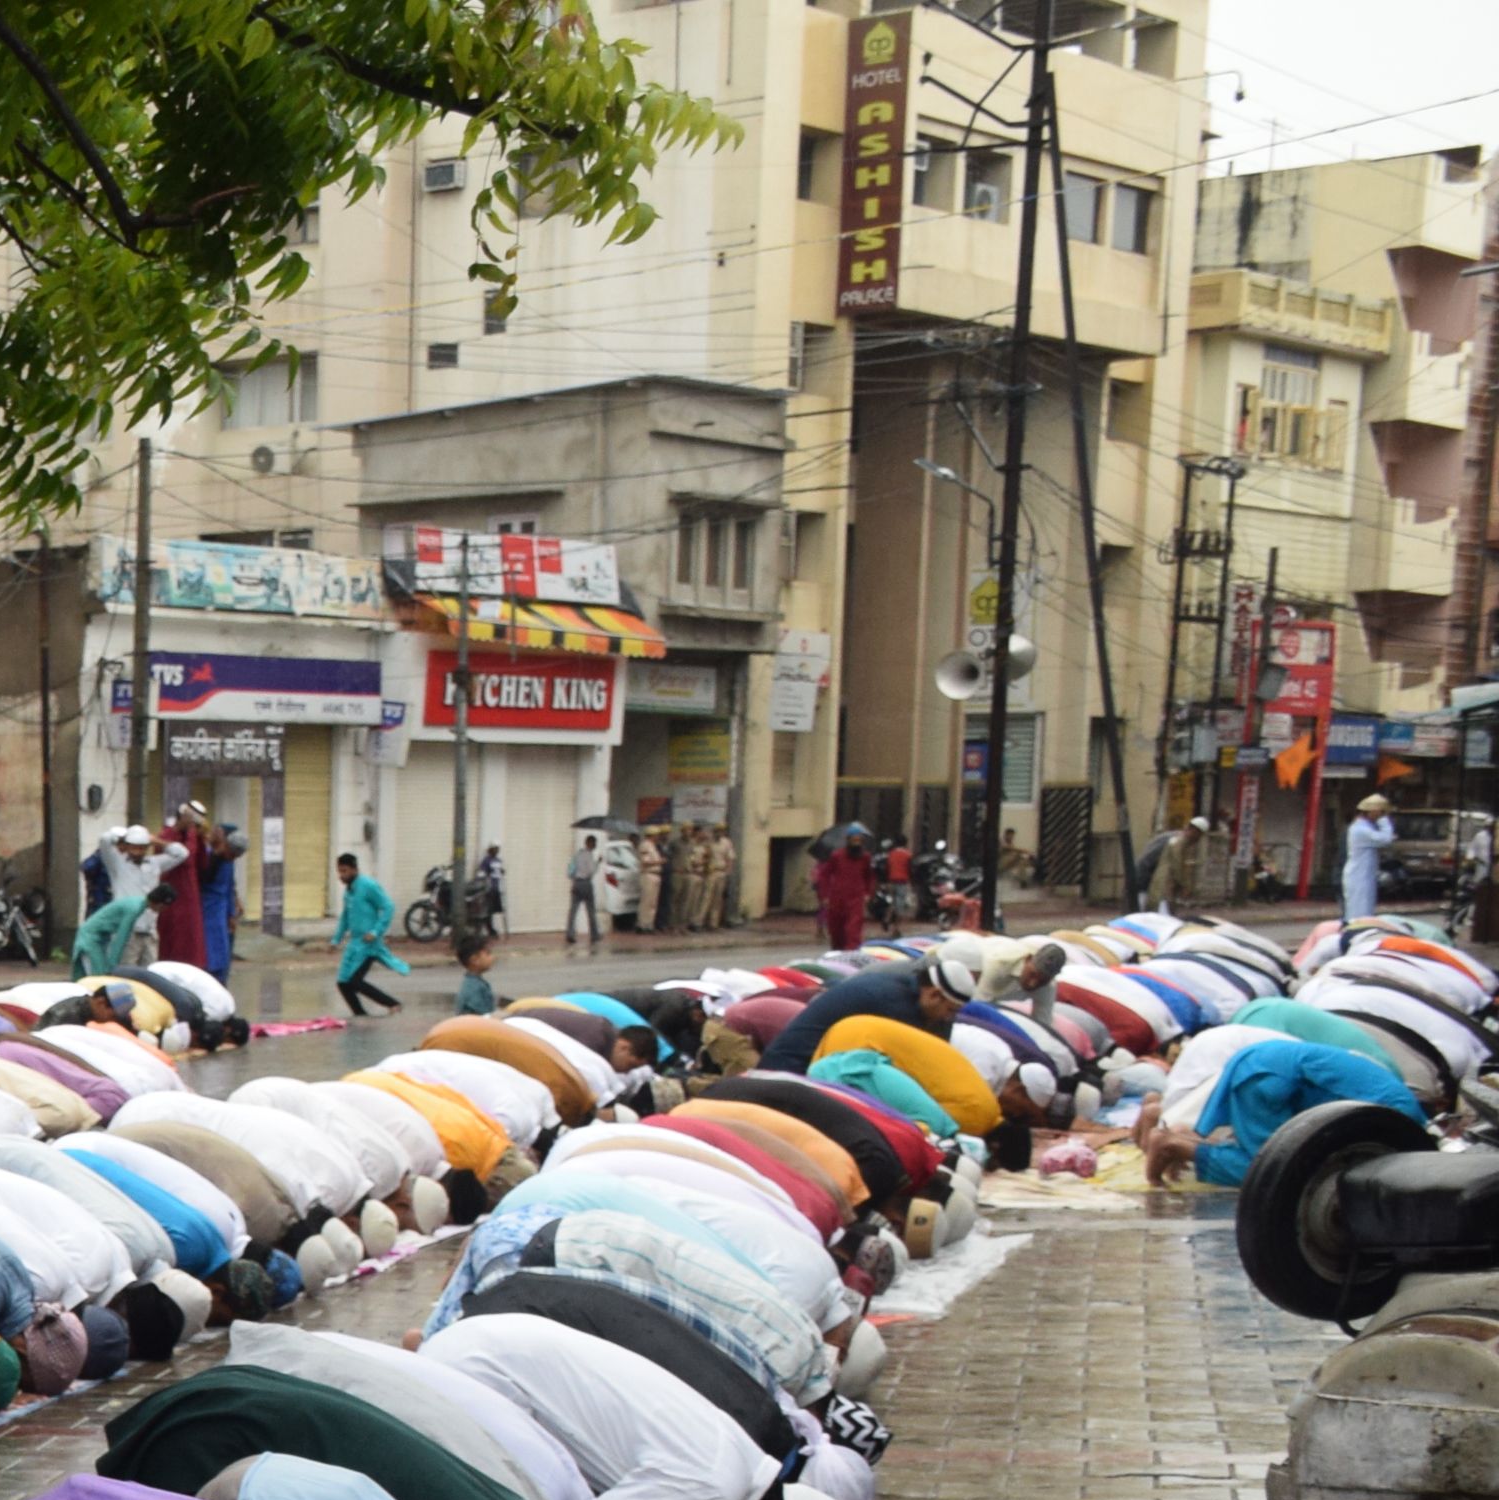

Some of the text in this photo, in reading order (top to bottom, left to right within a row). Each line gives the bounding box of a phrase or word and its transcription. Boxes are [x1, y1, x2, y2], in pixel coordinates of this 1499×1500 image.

[853, 67, 901, 88] HOTEL
[850, 101, 895, 284] ASHISH
[839, 286, 895, 307] PALACE
[151, 664, 185, 686] TVS
[444, 673, 546, 709] KTCHEN
[552, 677, 608, 712] KING
